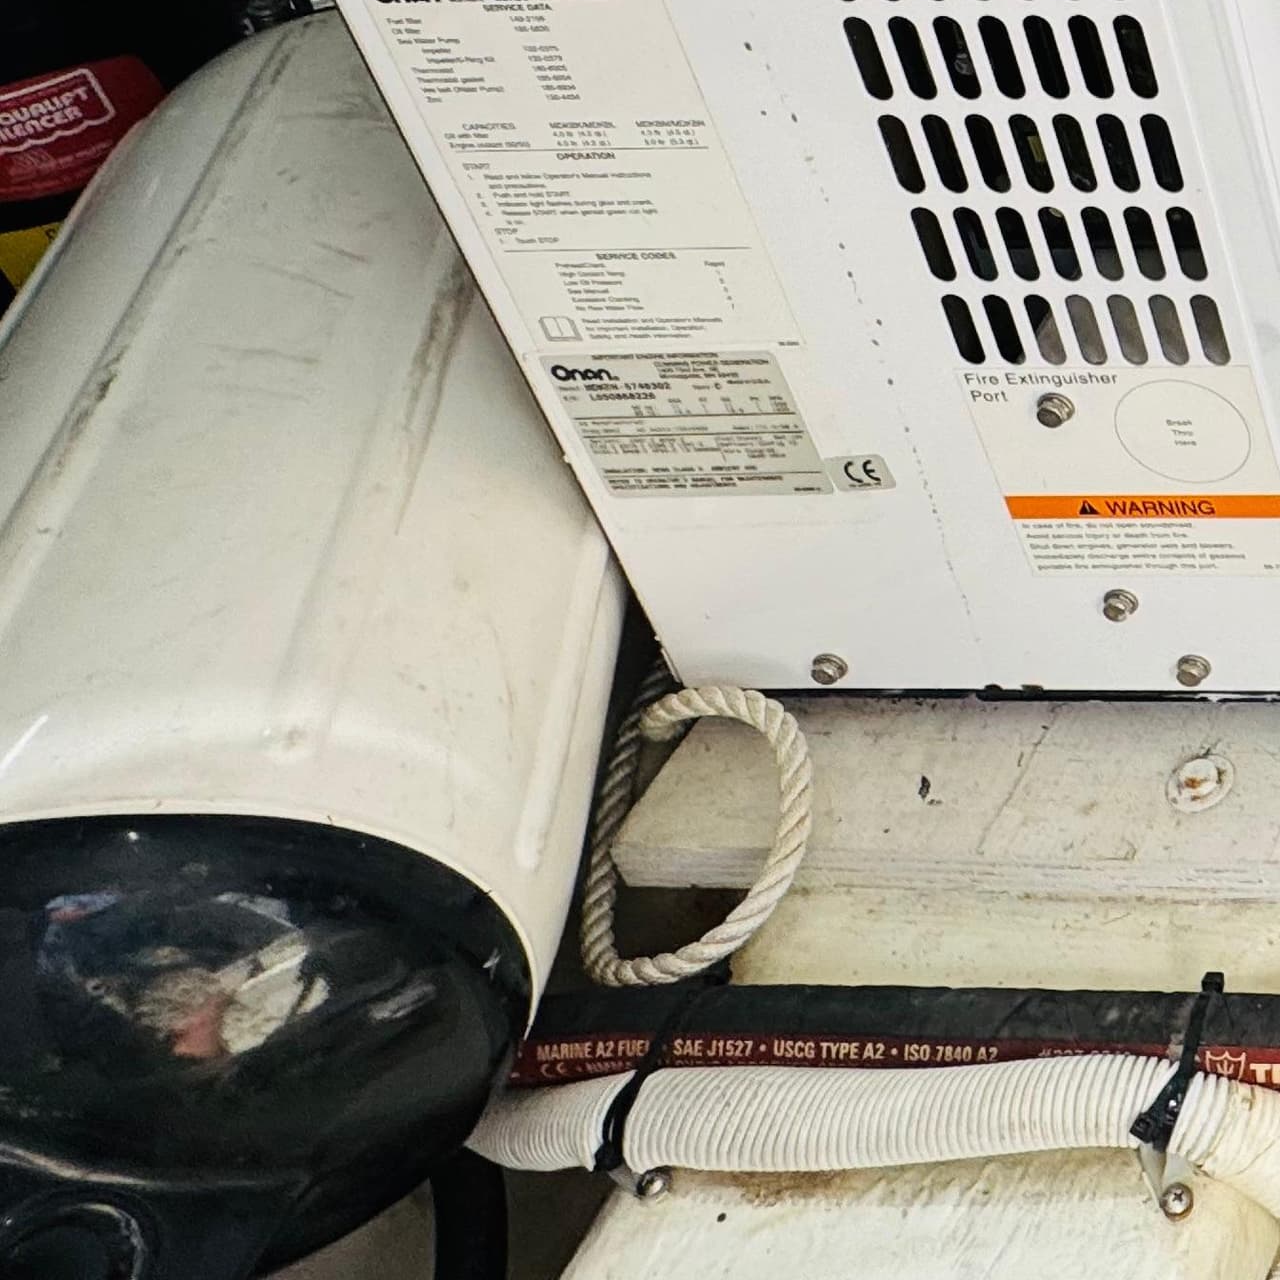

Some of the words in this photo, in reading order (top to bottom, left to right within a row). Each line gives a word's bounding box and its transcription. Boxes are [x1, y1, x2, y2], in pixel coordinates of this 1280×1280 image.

[550, 364, 613, 381] Onan
[962, 373, 1003, 384] Fire
[1003, 372, 1120, 386] Extinguisher
[968, 390, 1008, 401] Port
[844, 459, 881, 483] CE
[1106, 500, 1216, 516] WARNING
[537, 1041, 593, 1061] MARINE
[596, 1040, 614, 1058] A2
[618, 1040, 649, 1057] FUE
[672, 1039, 703, 1056] SAE
[707, 1040, 753, 1057] J1527
[773, 1040, 815, 1058] USCG
[820, 1042, 859, 1060] TYPE
[863, 1042, 885, 1060] A2
[903, 1044, 930, 1061] ISO
[936, 1045, 972, 1062] 7840
[976, 1046, 998, 1062] A2
